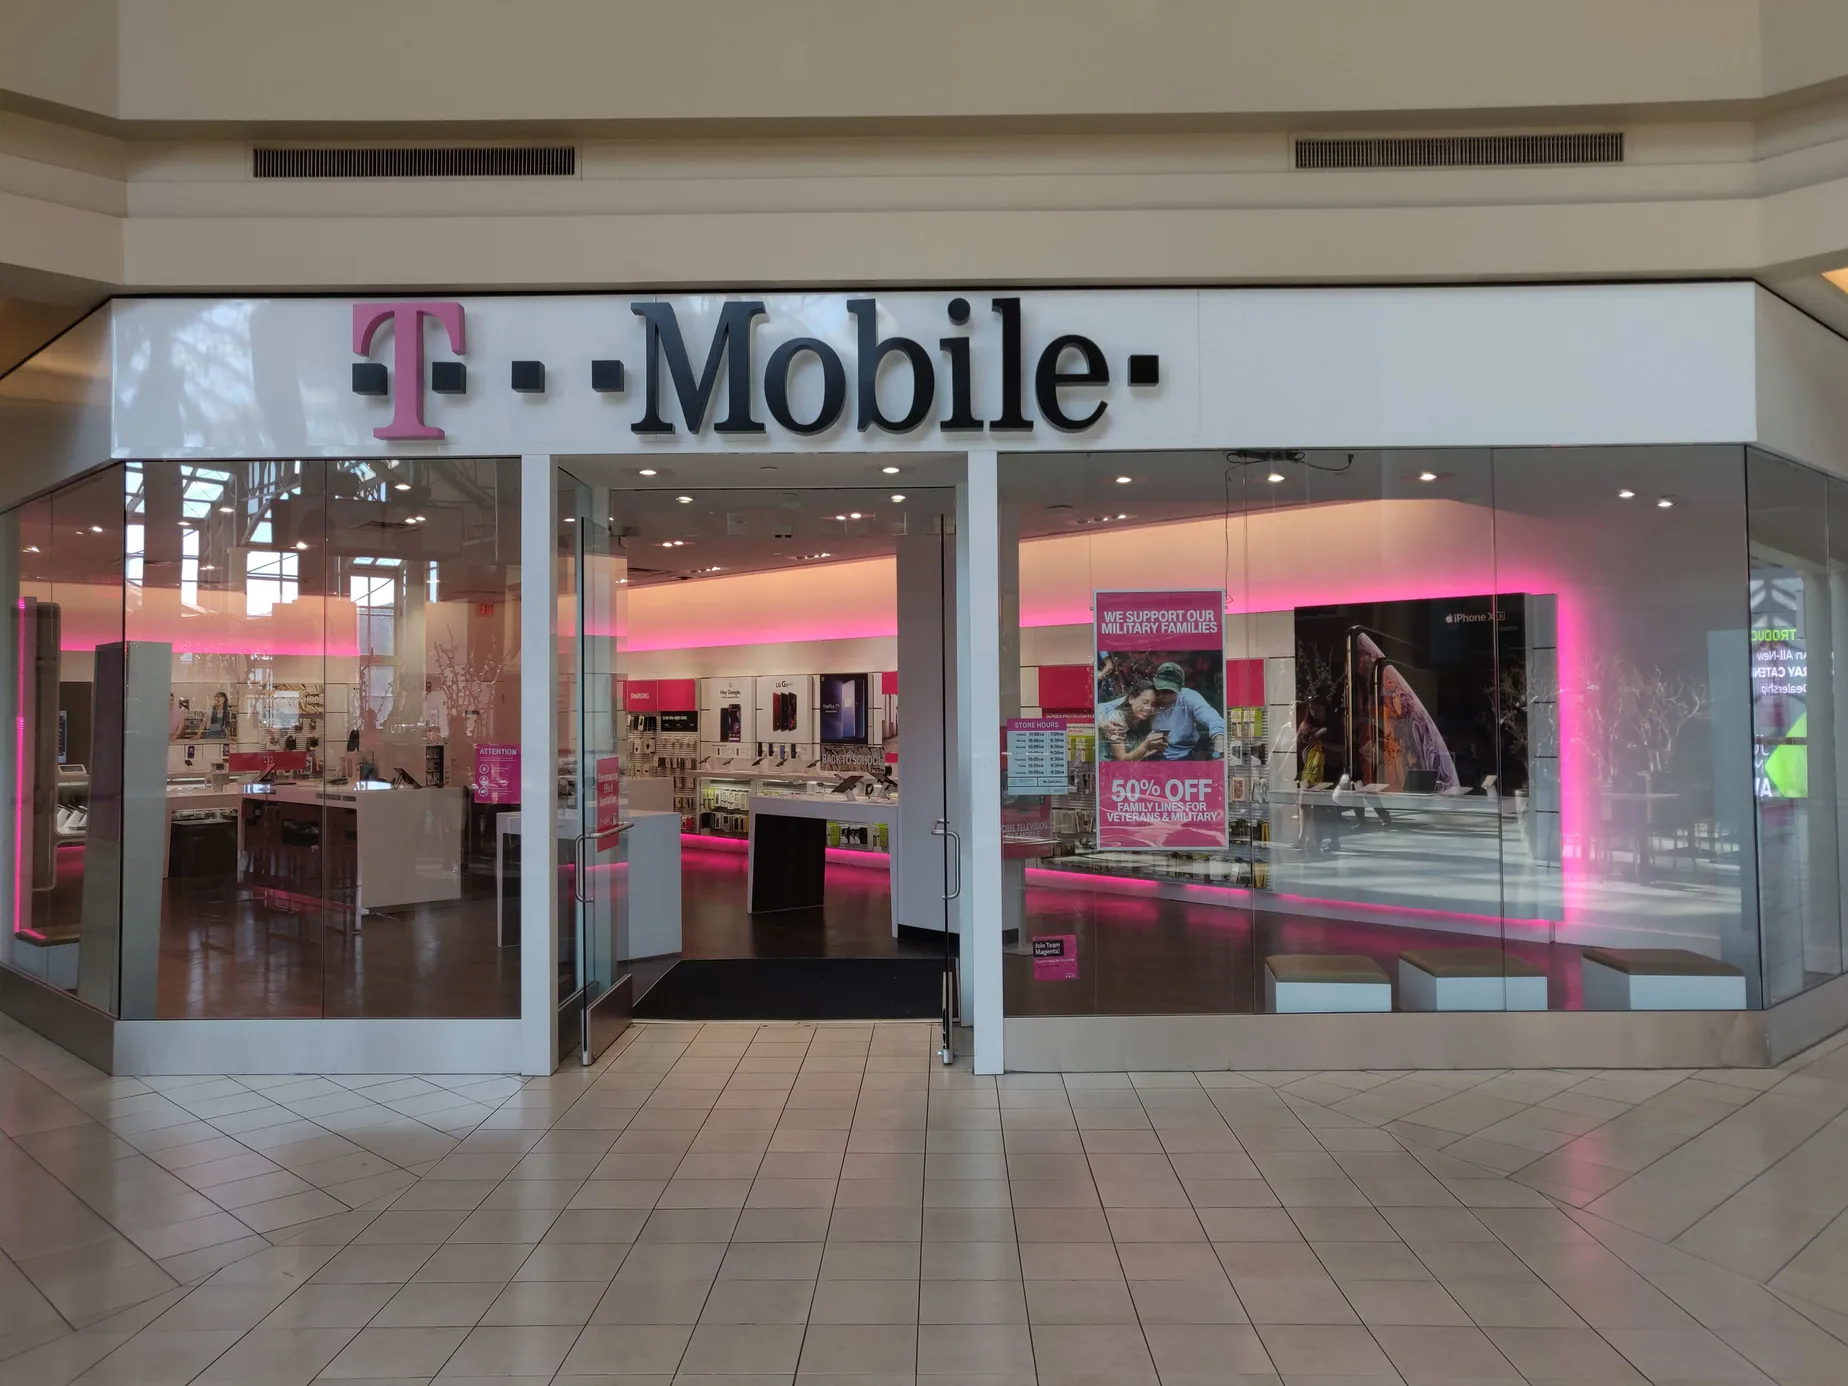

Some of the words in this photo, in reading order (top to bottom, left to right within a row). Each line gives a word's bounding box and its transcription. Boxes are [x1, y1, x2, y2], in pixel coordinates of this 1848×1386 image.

[1104, 611, 1124, 623] WE
[1126, 610, 1184, 622] SUPPORT
[1187, 610, 1215, 622] OUR
[1454, 613, 1486, 623] iPhone
[1101, 622, 1159, 634] MILITARY
[1161, 621, 1218, 634] FAMILIES
[479, 748, 517, 756] ATTENTION
[852, 754, 881, 766] SCHOOL
[1111, 779, 1161, 802] 50%
[1164, 779, 1213, 802] OFF
[1117, 802, 1154, 812] FAMILY
[1155, 802, 1184, 812] LINES
[1185, 802, 1207, 812] FOR
[1107, 812, 1160, 822] VETERANS
[1162, 812, 1170, 821] &
[1171, 812, 1218, 821] MILITARY
[1036, 948, 1060, 956] Magenta!
